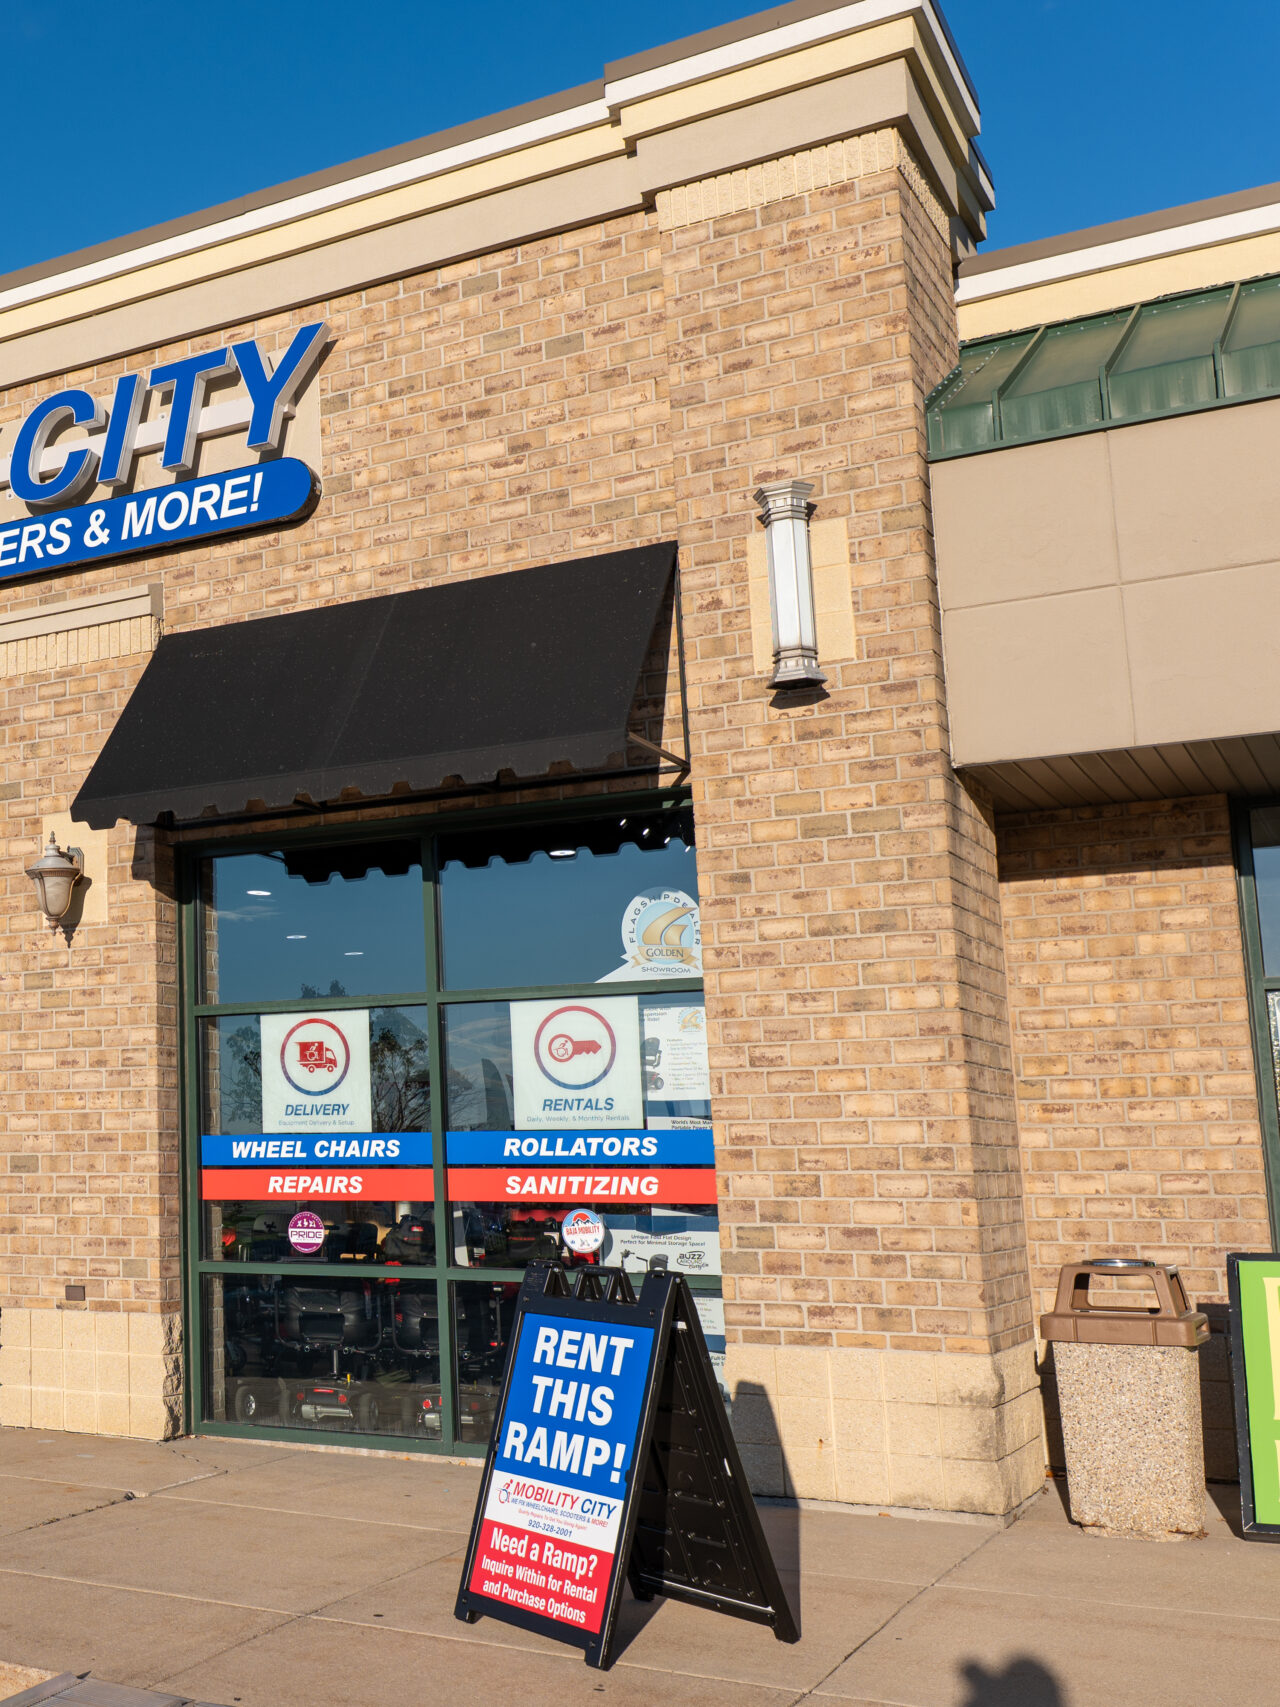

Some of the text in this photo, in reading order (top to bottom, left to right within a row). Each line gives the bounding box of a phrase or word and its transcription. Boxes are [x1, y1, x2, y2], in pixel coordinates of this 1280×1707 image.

[9, 321, 326, 503] CITY
[83, 508, 110, 548] &
[121, 471, 264, 540] MORE!
[673, 896, 701, 945] DEALER
[646, 948, 684, 958] GOLDEN
[641, 966, 691, 974] SHOWROOM
[284, 1103, 350, 1117] DELIVERY
[542, 1097, 615, 1111] RENTALS
[578, 1115, 604, 1123] Monthly
[605, 1114, 630, 1122] Rentals
[232, 1139, 401, 1158] WHEEL CHAIRS
[503, 1136, 658, 1157] ROLLATORS
[268, 1175, 363, 1194] REPAIRS
[505, 1175, 659, 1196] SANITIZING
[290, 1230, 322, 1239] PRIDE
[565, 1225, 600, 1236] BAJA MOBILITY
[532, 1326, 635, 1376] RENT
[532, 1374, 615, 1427] THIS
[502, 1420, 626, 1484] RAMP!
[513, 1481, 617, 1519] MOBILITY CITY
[527, 1519, 572, 1538] 920-328-2001
[559, 1509, 586, 1522] SCOOTERS
[590, 1518, 609, 1528] MORE!
[490, 1526, 598, 1580] Need a Ramp?
[481, 1554, 598, 1603] Inquire Within for Rental
[482, 1580, 586, 1624] and Purchase Options
